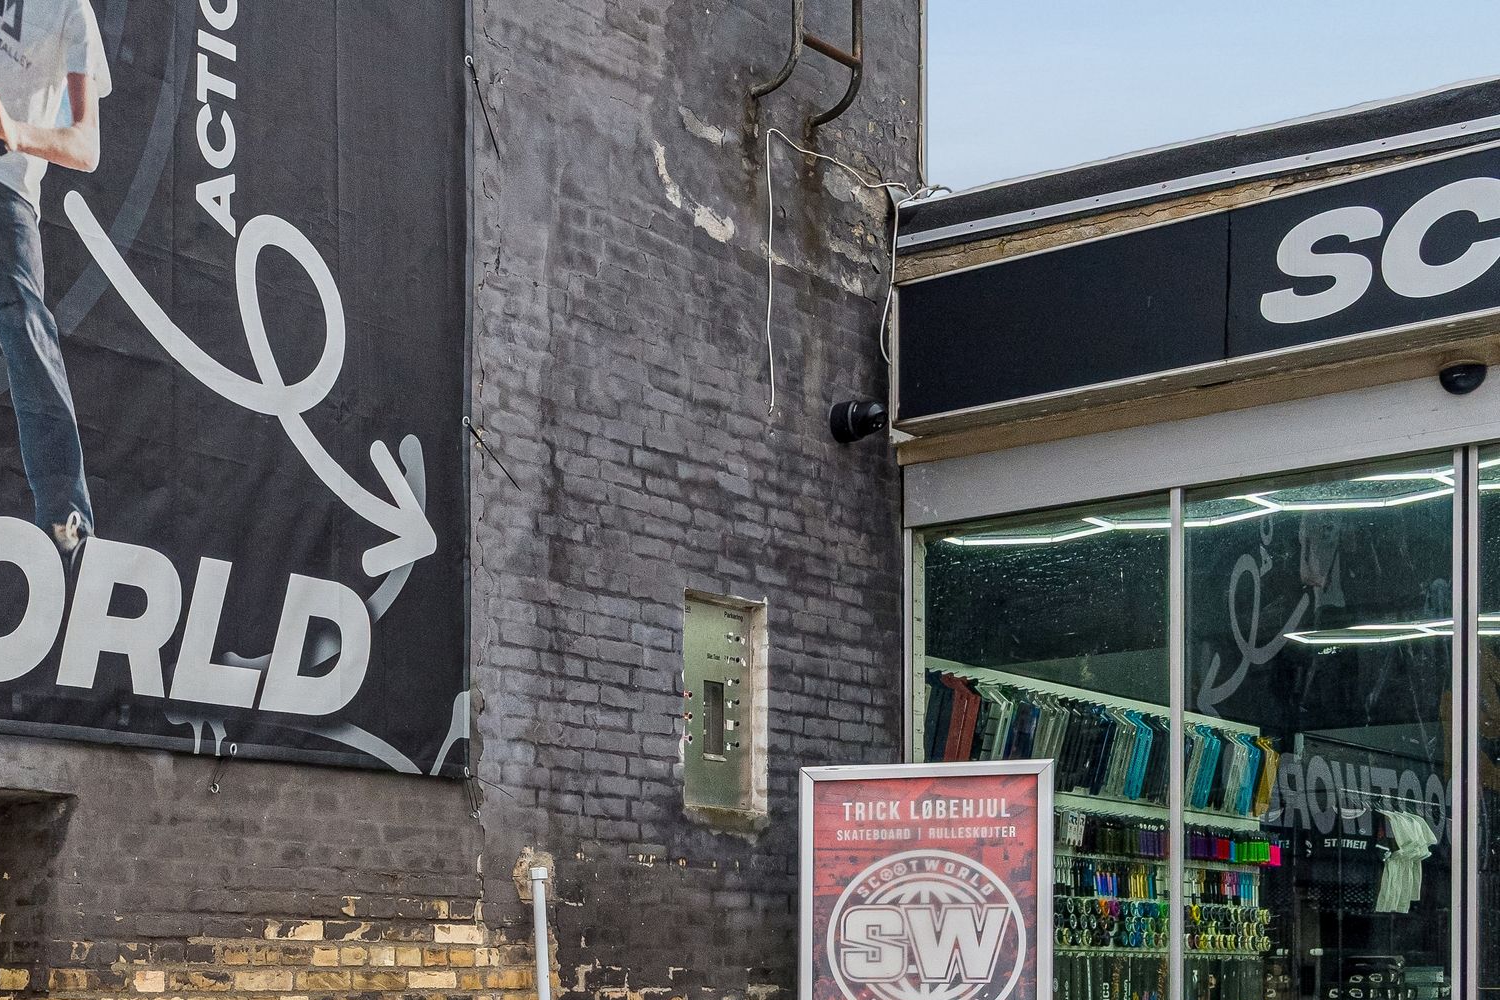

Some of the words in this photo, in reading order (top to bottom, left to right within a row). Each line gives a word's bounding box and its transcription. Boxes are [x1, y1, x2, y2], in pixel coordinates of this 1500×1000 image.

[1260, 177, 1500, 324] SC
[836, 828, 911, 841] SKATEBOARD
[929, 826, 1016, 839] RULLESKØJTER
[843, 801, 900, 821] TRICK
[910, 798, 1011, 820] LØBEHJUL
[840, 902, 1012, 984] SW
